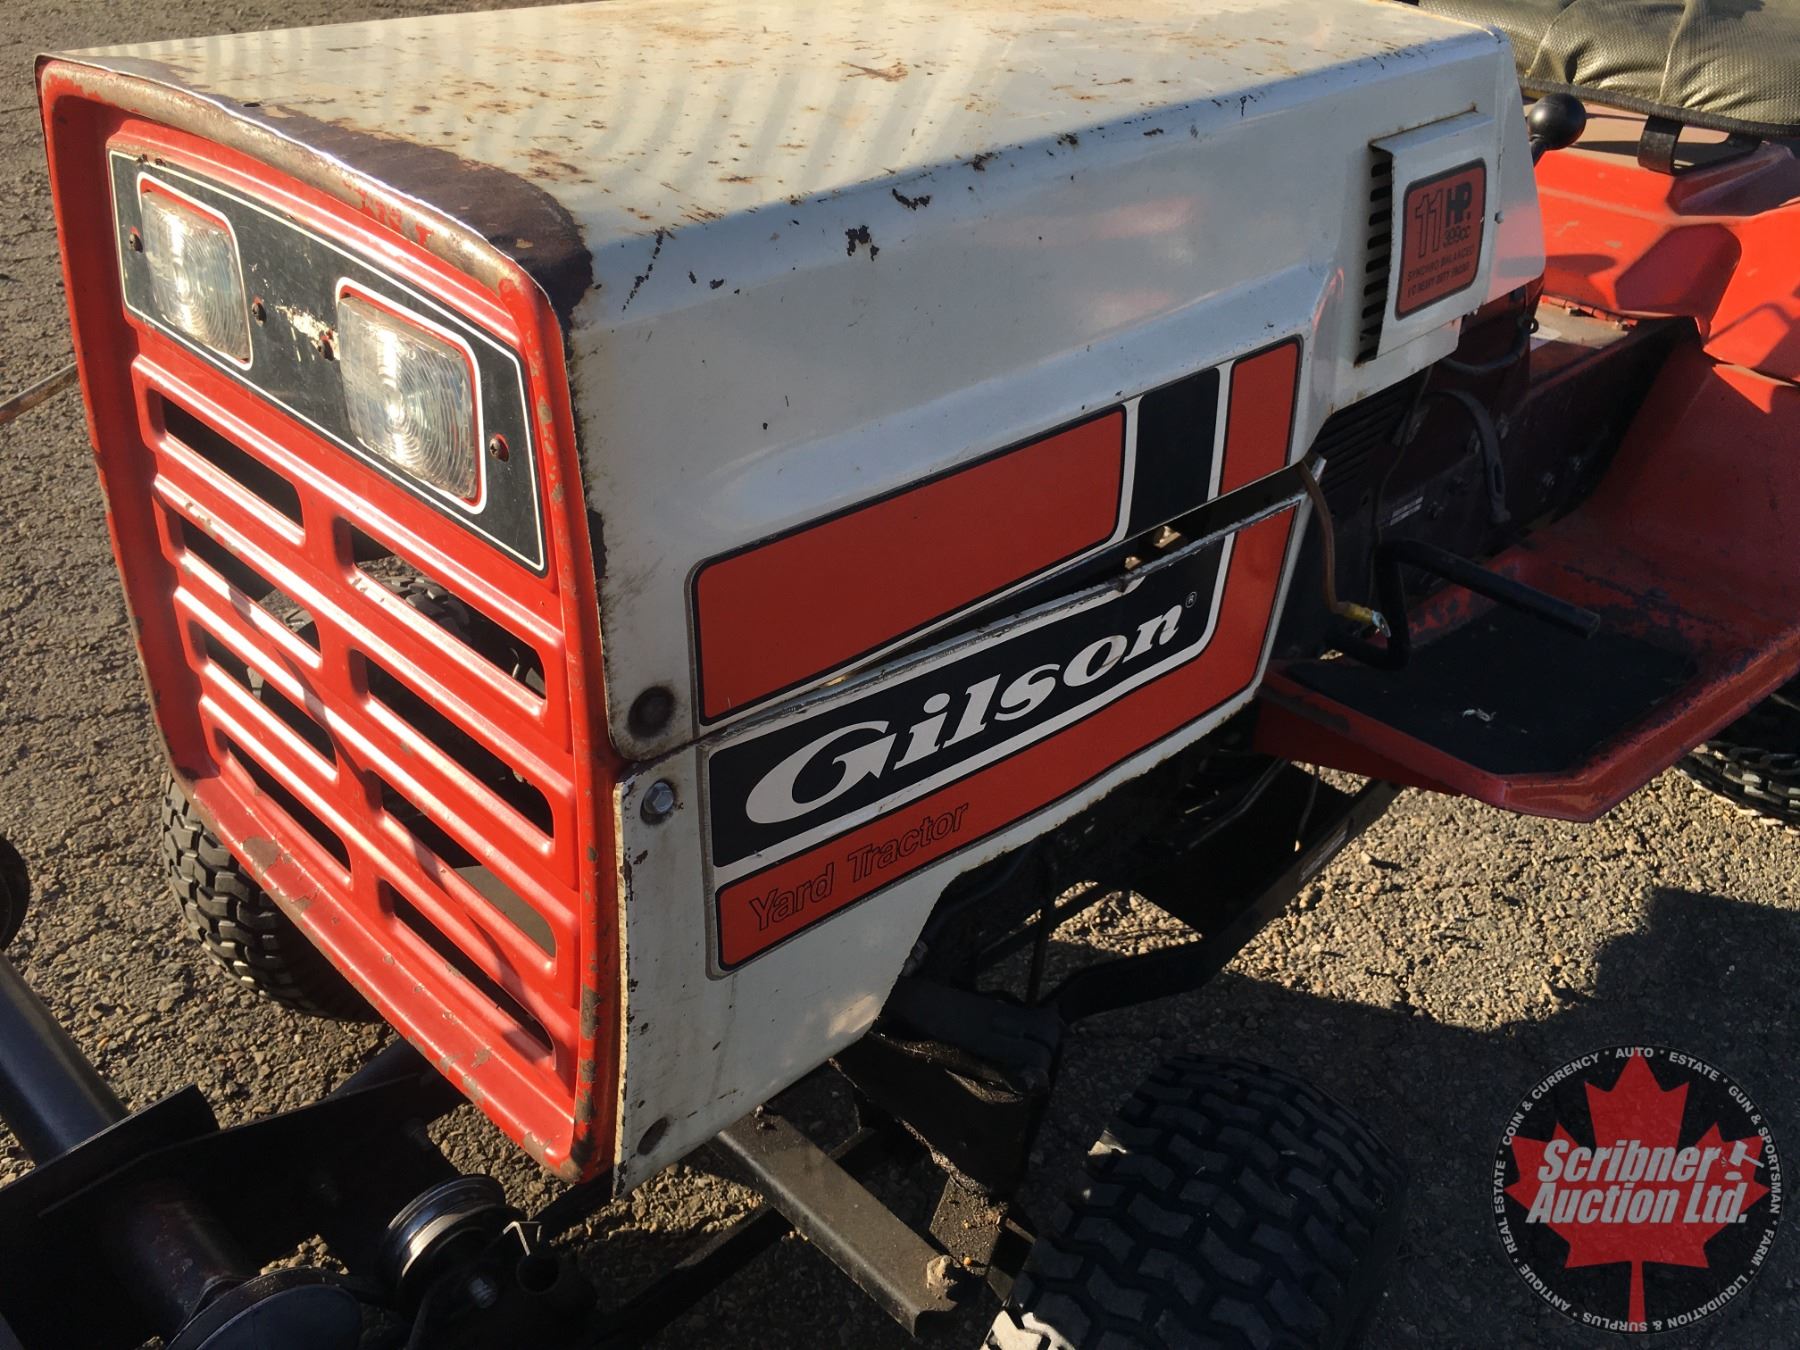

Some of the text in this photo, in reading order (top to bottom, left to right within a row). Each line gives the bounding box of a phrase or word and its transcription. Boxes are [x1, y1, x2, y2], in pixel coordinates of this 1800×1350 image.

[1415, 188, 1443, 259] 11
[749, 802, 970, 932] Yard Tractor
